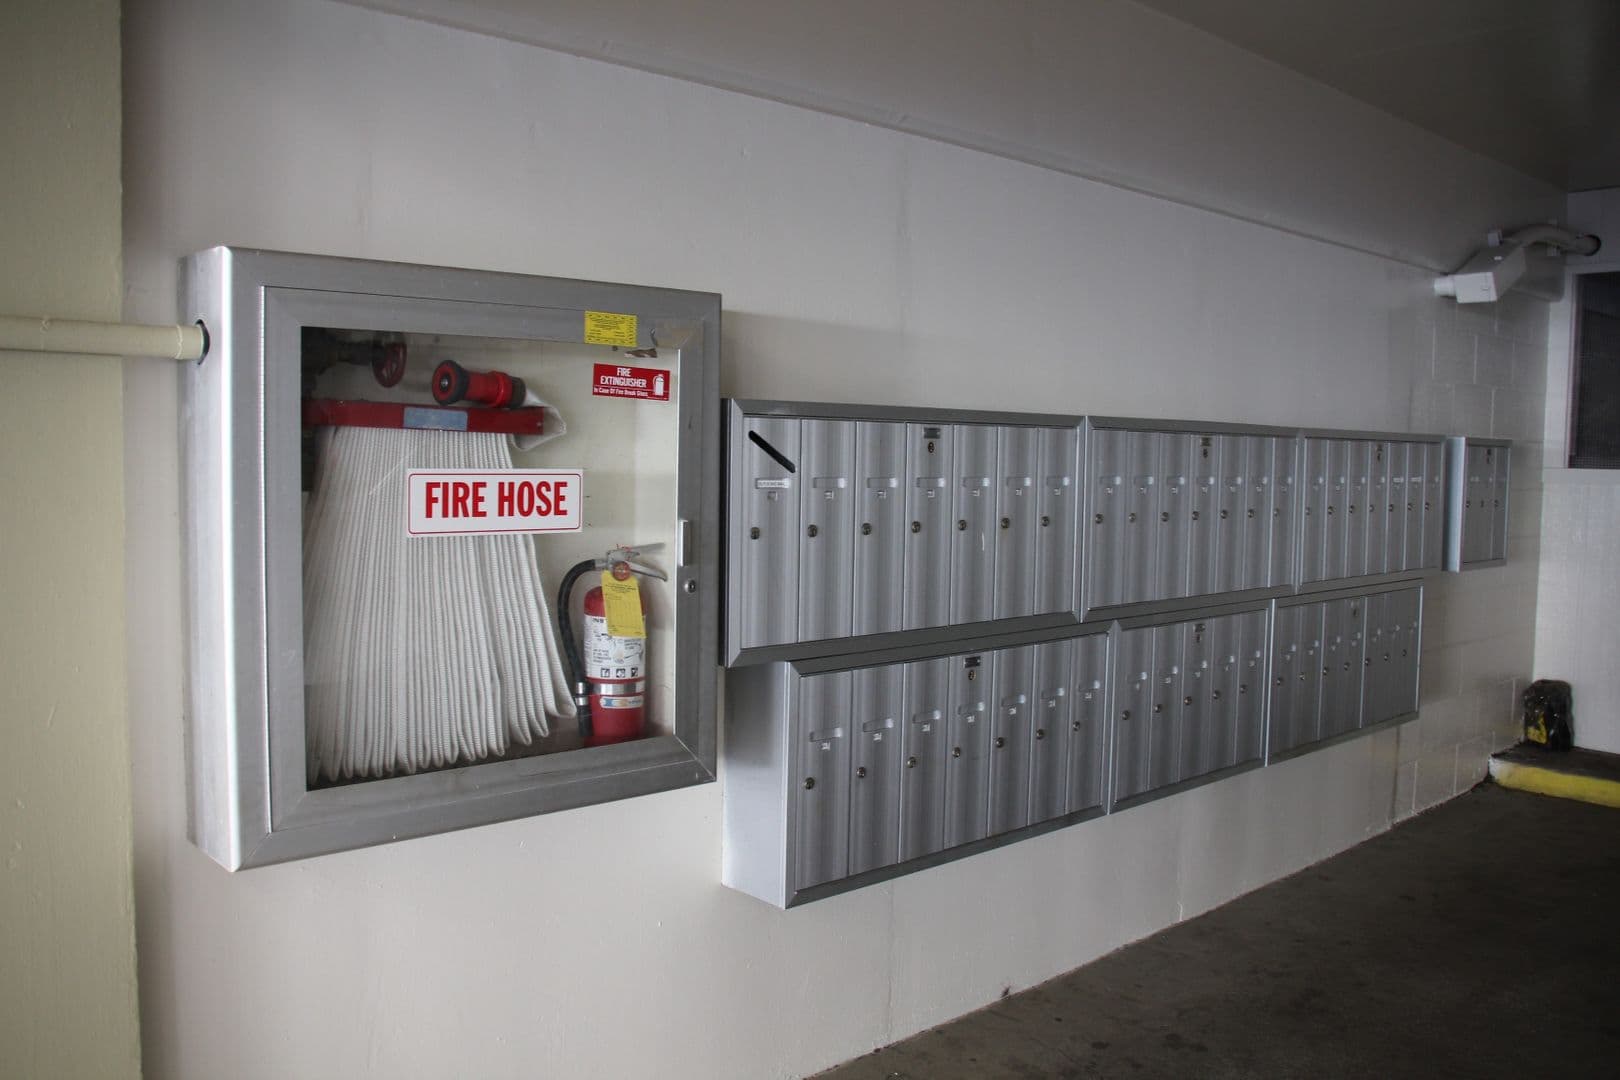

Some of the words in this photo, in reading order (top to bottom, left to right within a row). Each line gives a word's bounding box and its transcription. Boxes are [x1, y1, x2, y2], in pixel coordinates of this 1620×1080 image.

[617, 367, 632, 376] FIRE
[600, 376, 647, 388] EXTINGUISHER
[425, 481, 487, 518] FIRE
[498, 480, 568, 517] HOSE
